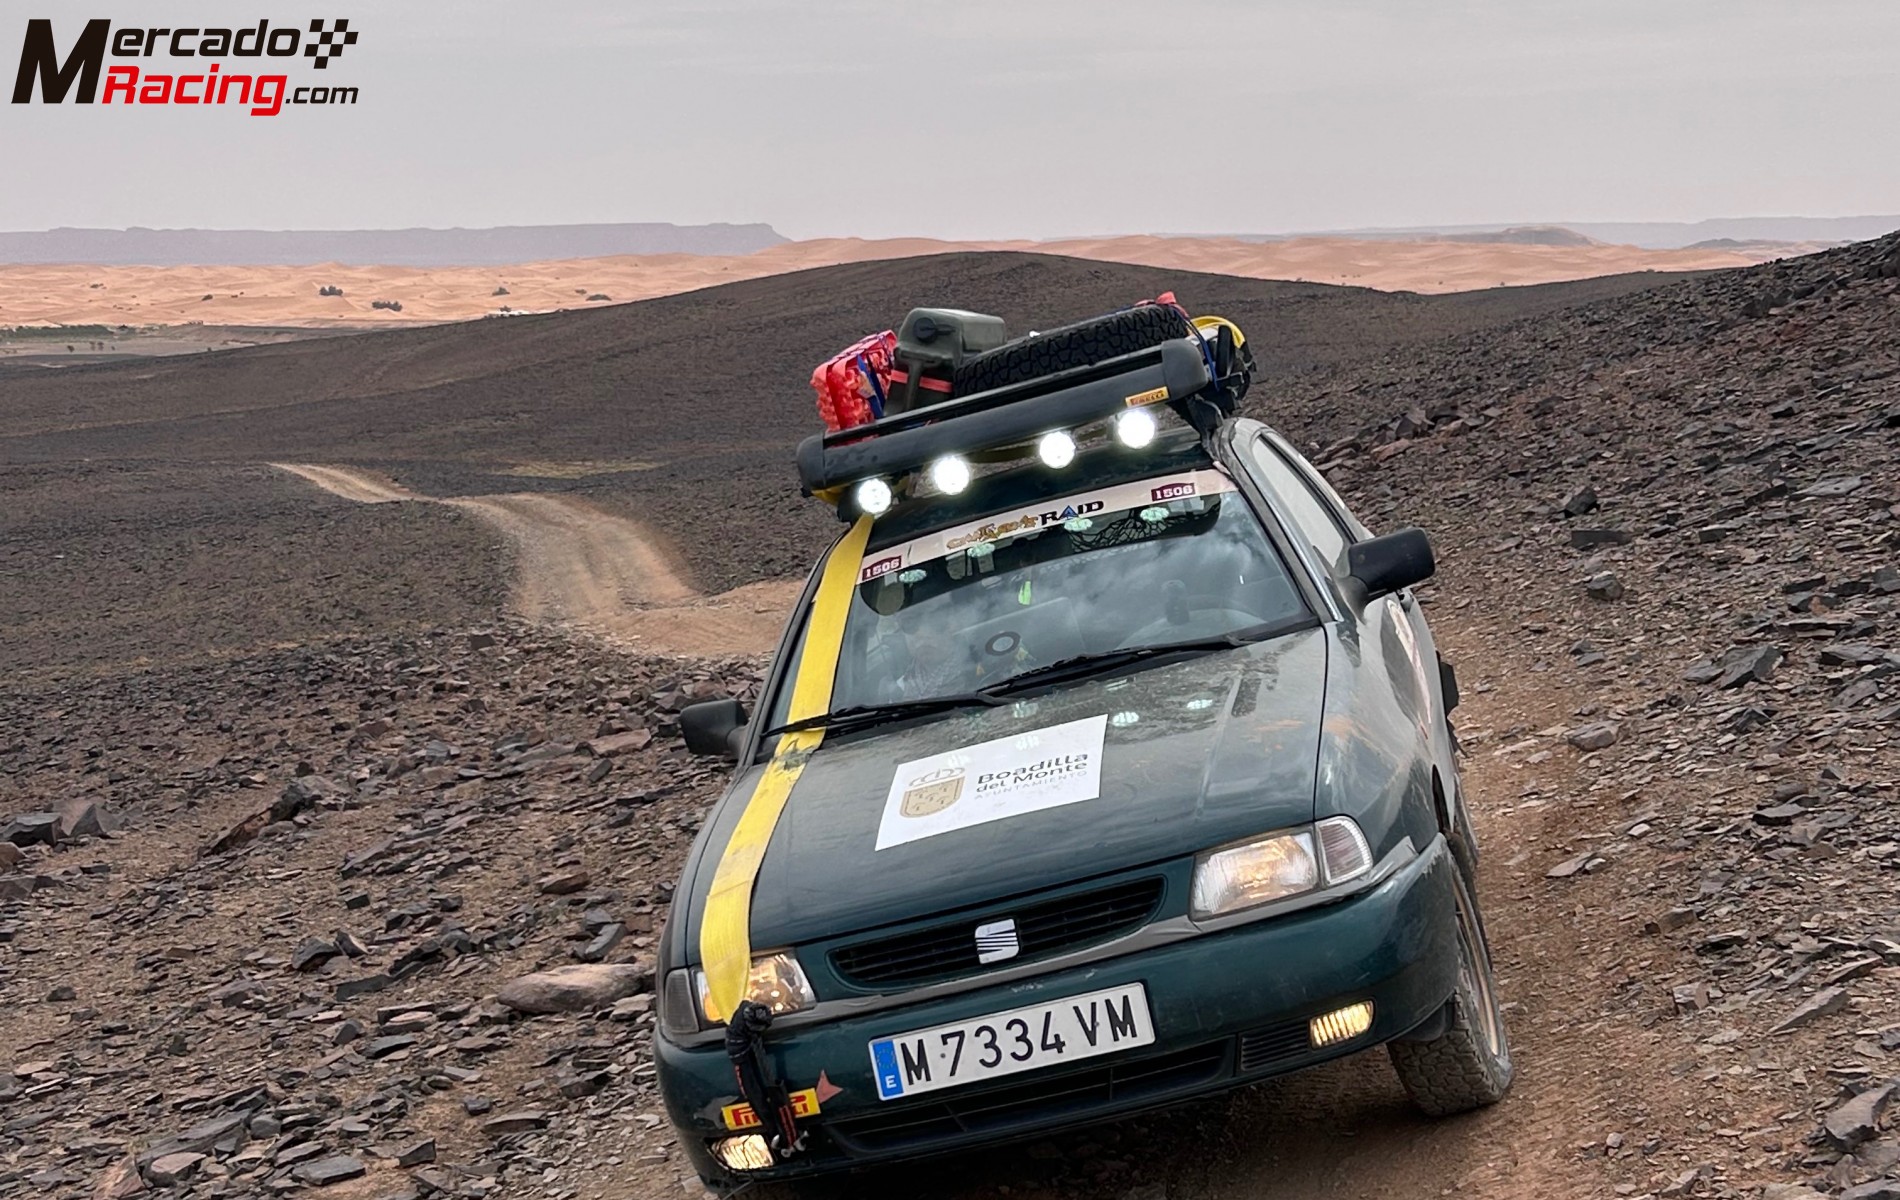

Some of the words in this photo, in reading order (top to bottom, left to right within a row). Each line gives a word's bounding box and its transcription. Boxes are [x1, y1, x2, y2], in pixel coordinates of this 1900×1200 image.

[1156, 485, 1193, 499] 1506
[1039, 501, 1104, 526] RAID
[866, 559, 900, 578] 1506
[976, 780, 1006, 792] del
[1013, 763, 1087, 784] Monte
[978, 754, 1088, 784] Boadilla
[901, 1039, 932, 1085] M
[941, 1011, 1065, 1077] 7334
[1073, 995, 1138, 1046] VM
[886, 1075, 897, 1088] E
